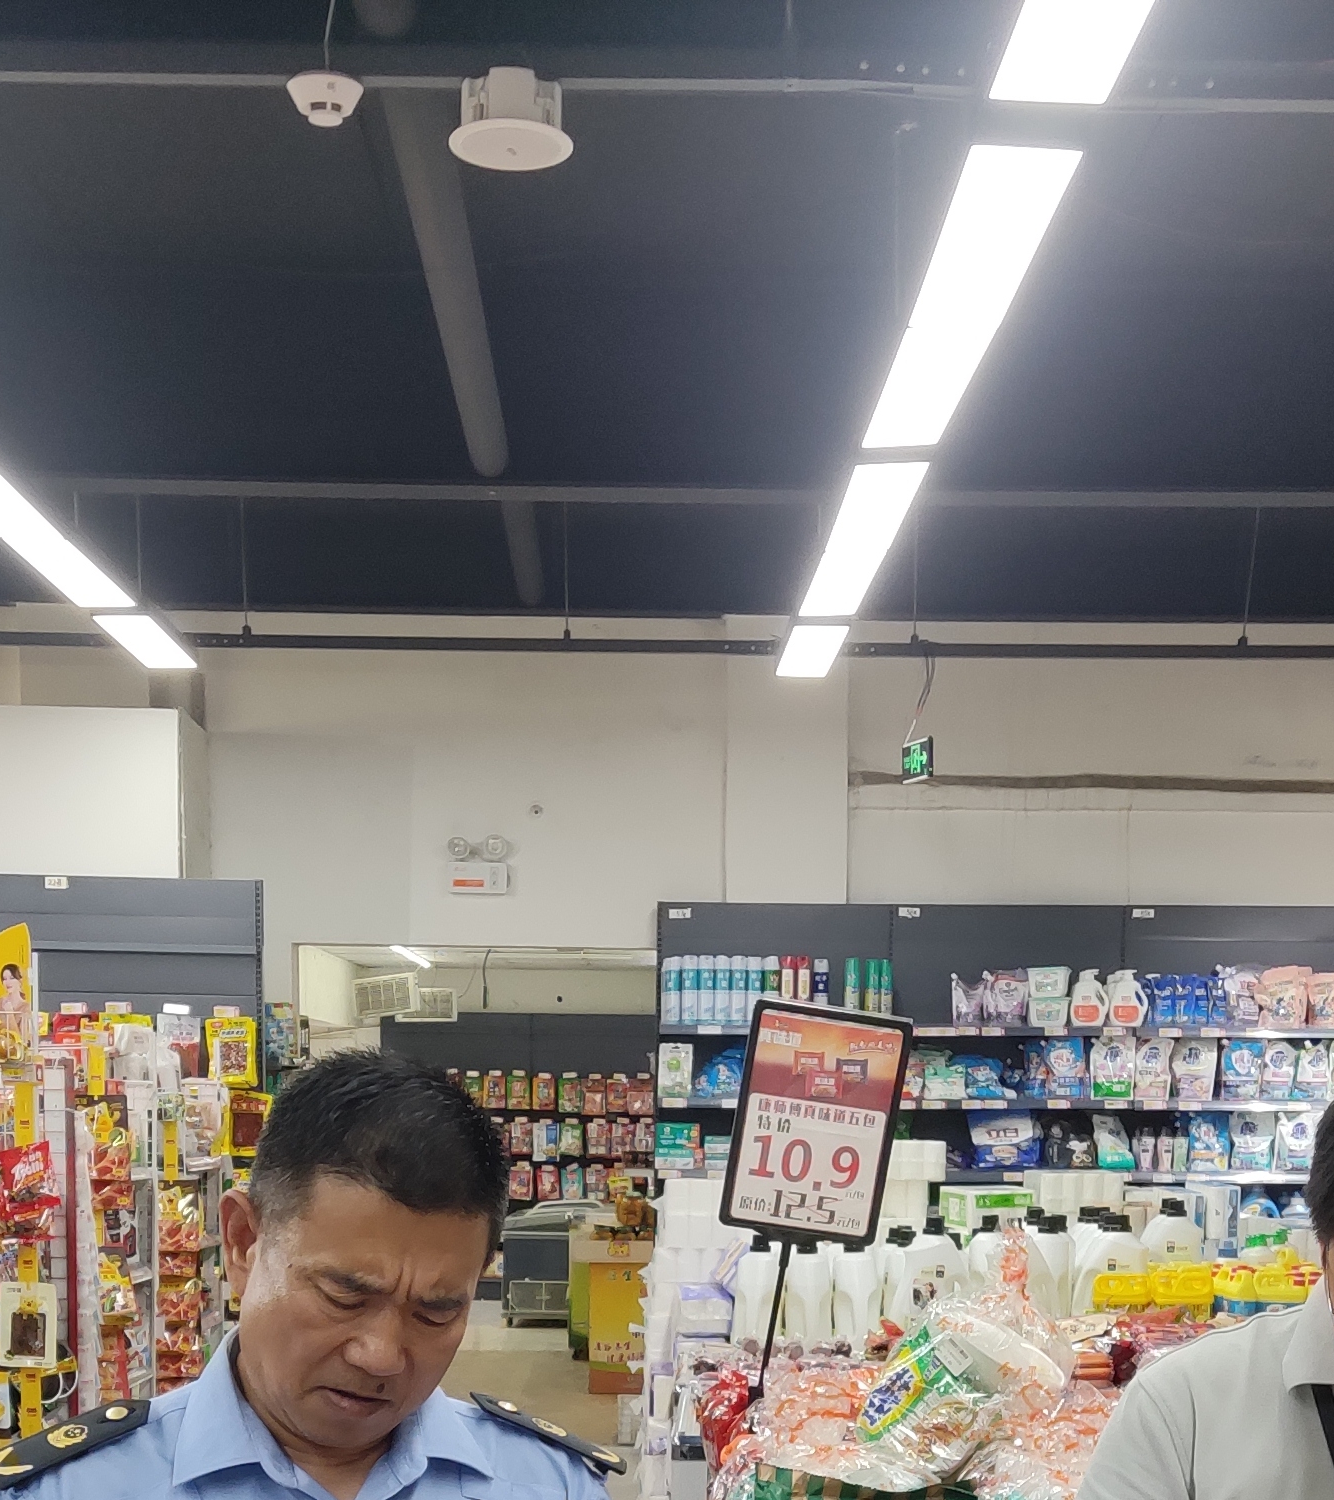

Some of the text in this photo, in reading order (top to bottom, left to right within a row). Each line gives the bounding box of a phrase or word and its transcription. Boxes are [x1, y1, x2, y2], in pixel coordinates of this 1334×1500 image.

[757, 1114, 791, 1134] 特价
[747, 1134, 860, 1192] 10.9
[769, 1188, 838, 1226] 12.5
